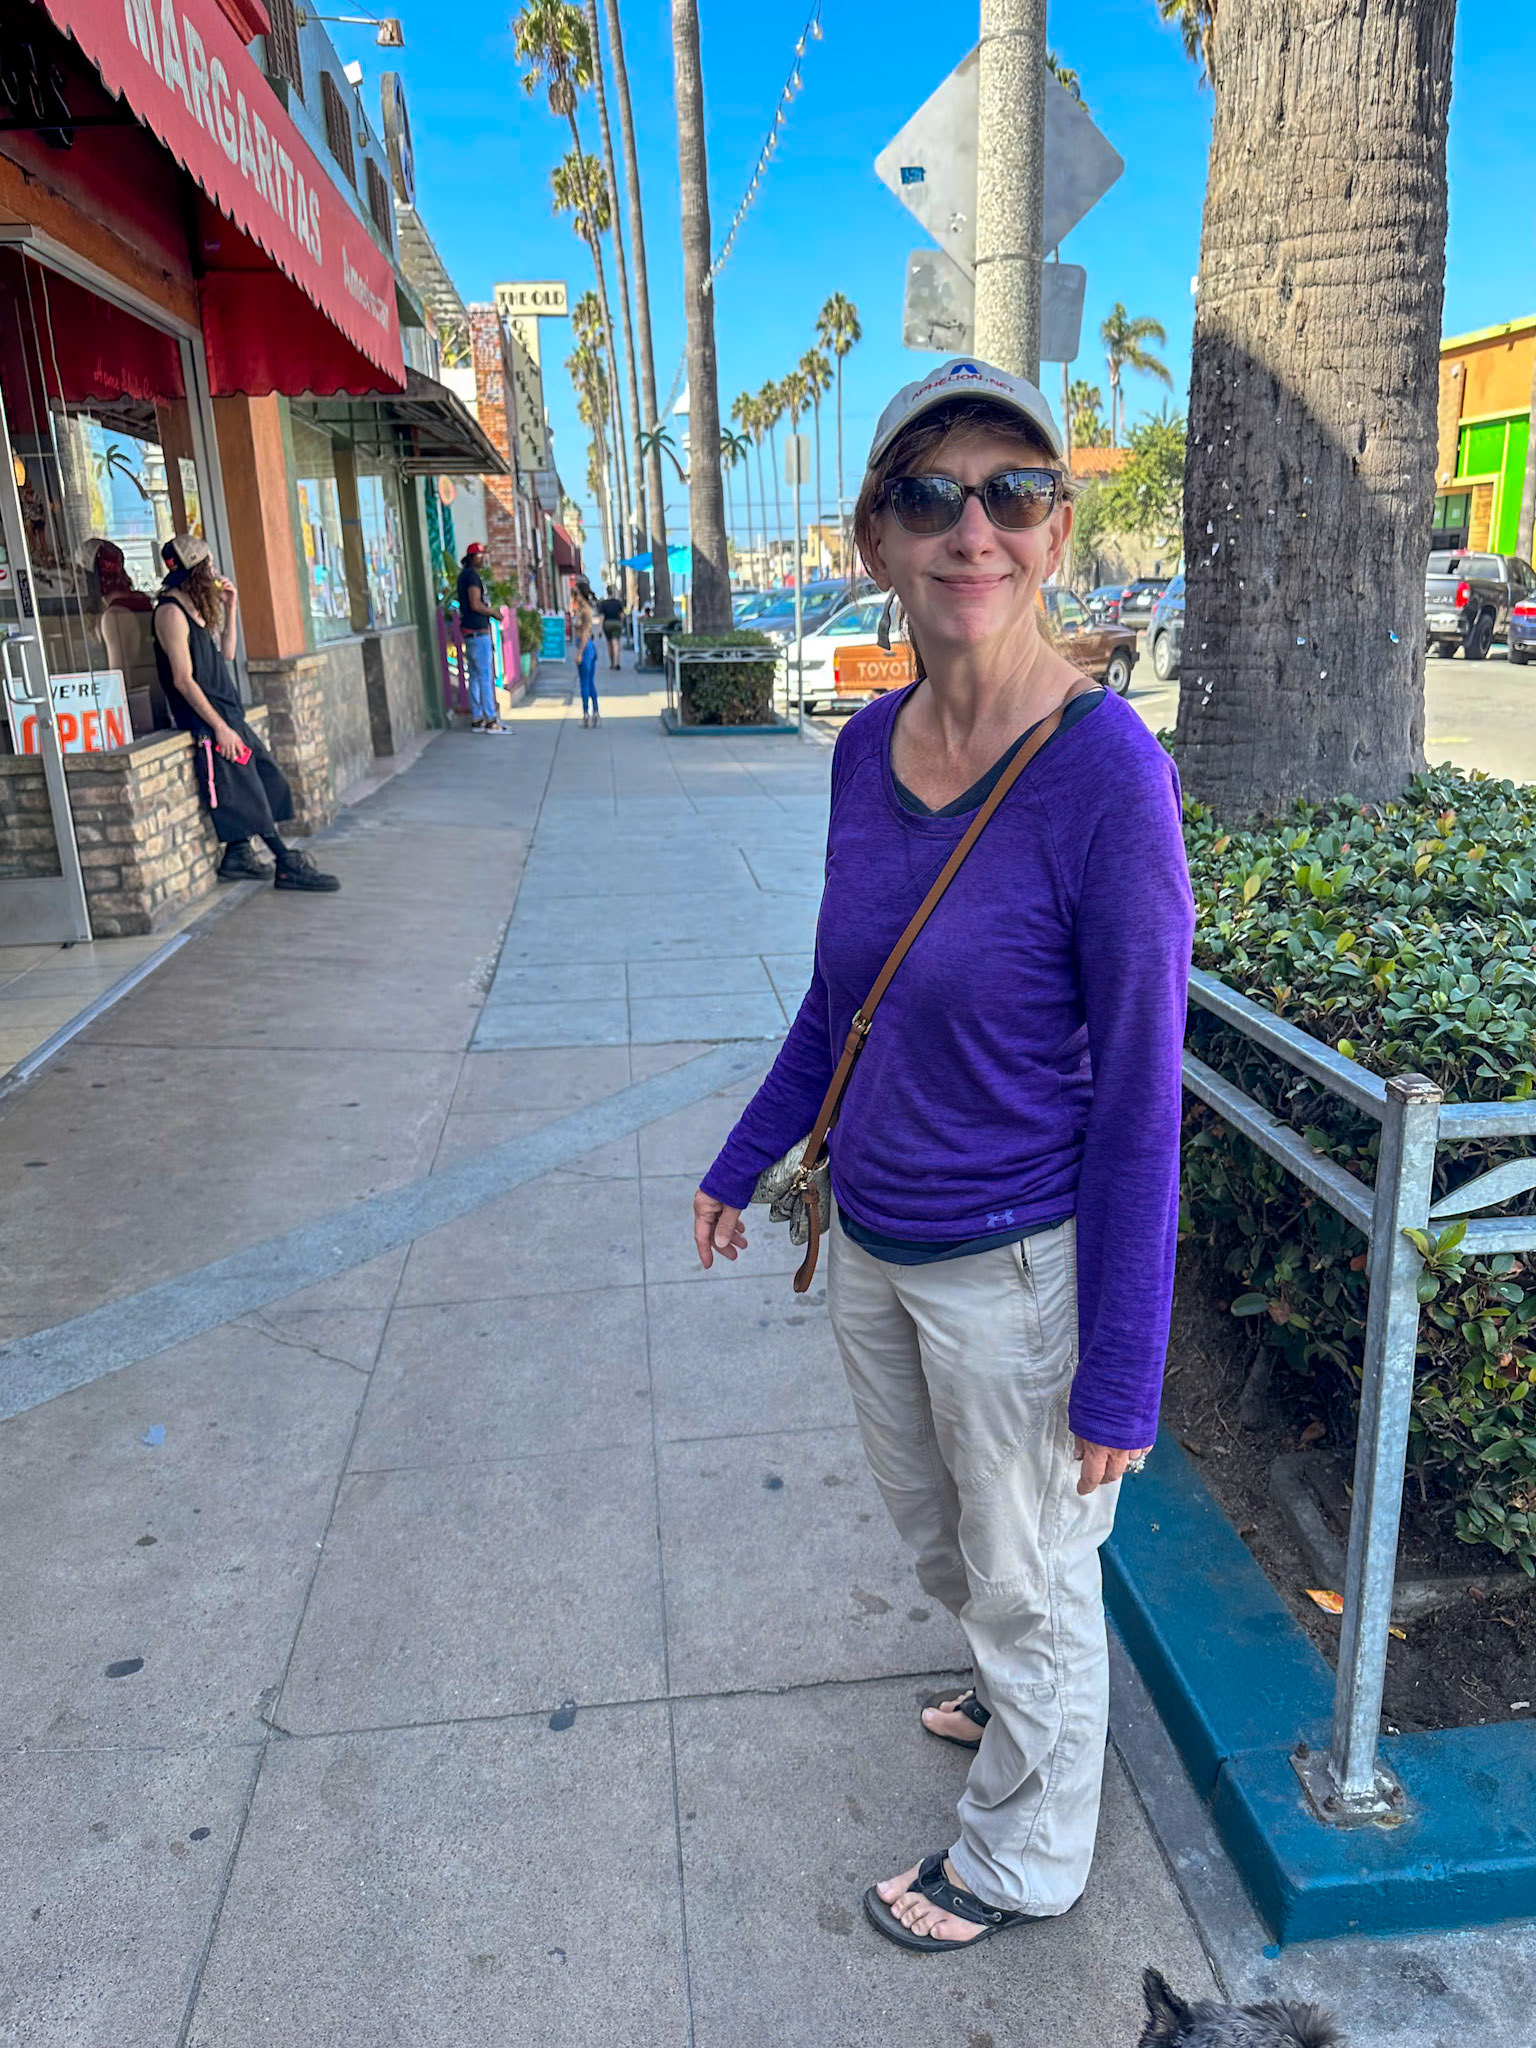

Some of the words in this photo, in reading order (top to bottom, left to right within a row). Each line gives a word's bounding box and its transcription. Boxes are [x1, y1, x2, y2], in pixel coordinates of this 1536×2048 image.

[499, 291, 527, 306] THE
[531, 290, 565, 306] OLD
[857, 661, 910, 678] TOYOT
[52, 682, 101, 700] E'RE
